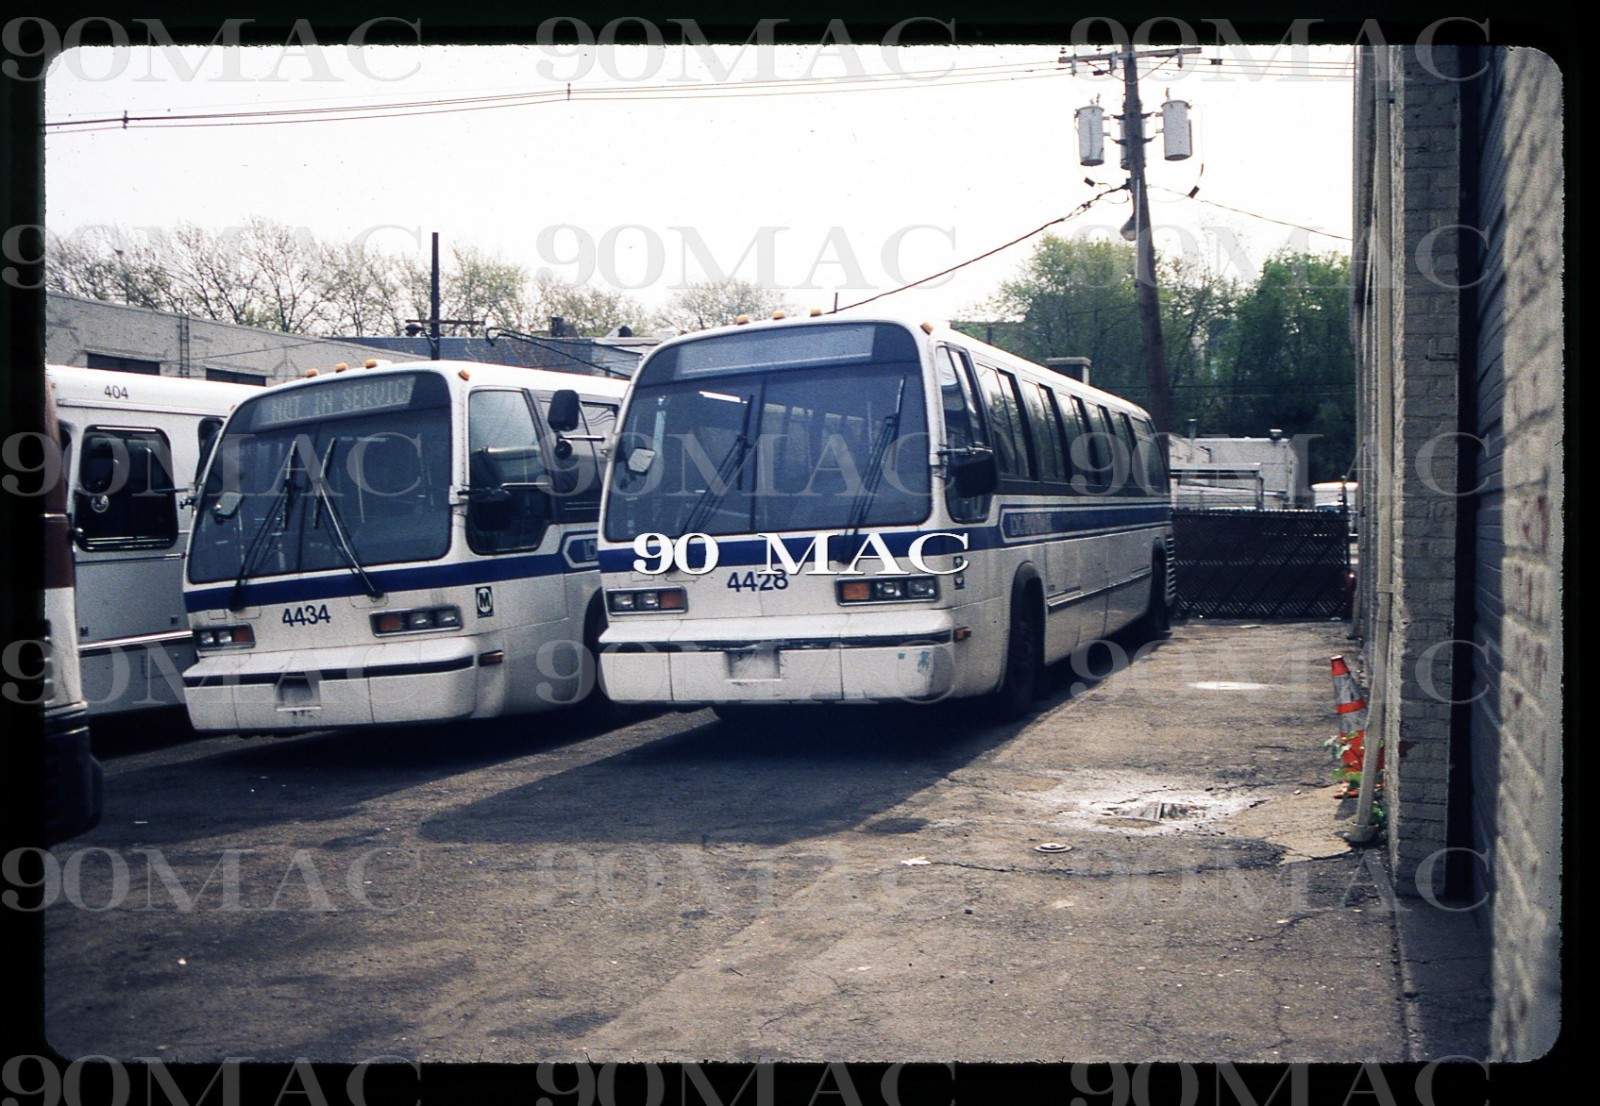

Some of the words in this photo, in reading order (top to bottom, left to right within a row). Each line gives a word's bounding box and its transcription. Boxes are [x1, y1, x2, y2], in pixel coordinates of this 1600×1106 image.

[104, 385, 128, 399] 404
[271, 394, 301, 422] NOT
[313, 389, 334, 416] IN
[727, 569, 788, 592] 4428
[282, 604, 331, 626] 4434
